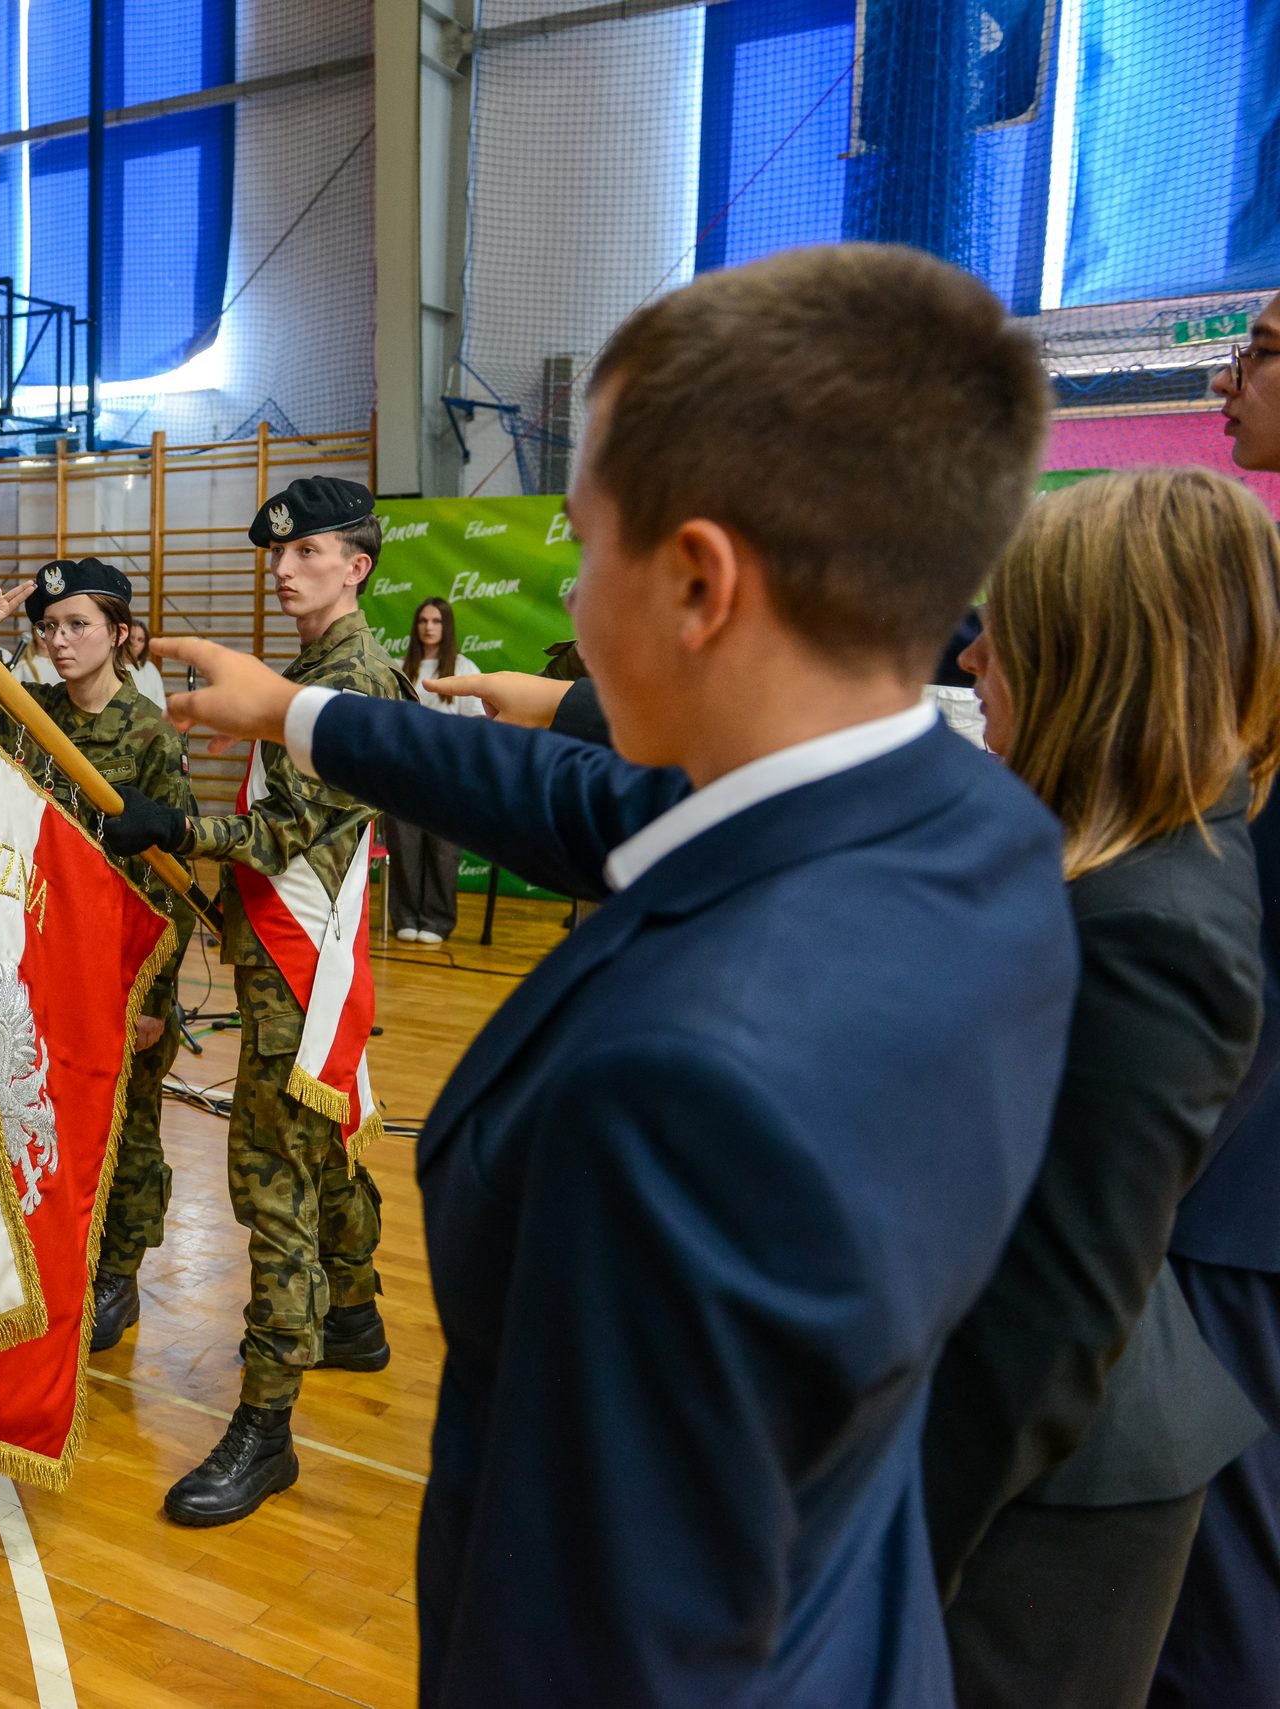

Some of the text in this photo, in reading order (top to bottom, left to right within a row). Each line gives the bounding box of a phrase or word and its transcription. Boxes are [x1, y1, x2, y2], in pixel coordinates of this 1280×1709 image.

[380, 516, 429, 544] konom
[464, 520, 508, 540] Ekonom
[372, 578, 413, 596] Ekonom
[448, 571, 521, 604] Ekonom
[461, 635, 504, 654] Ekonom
